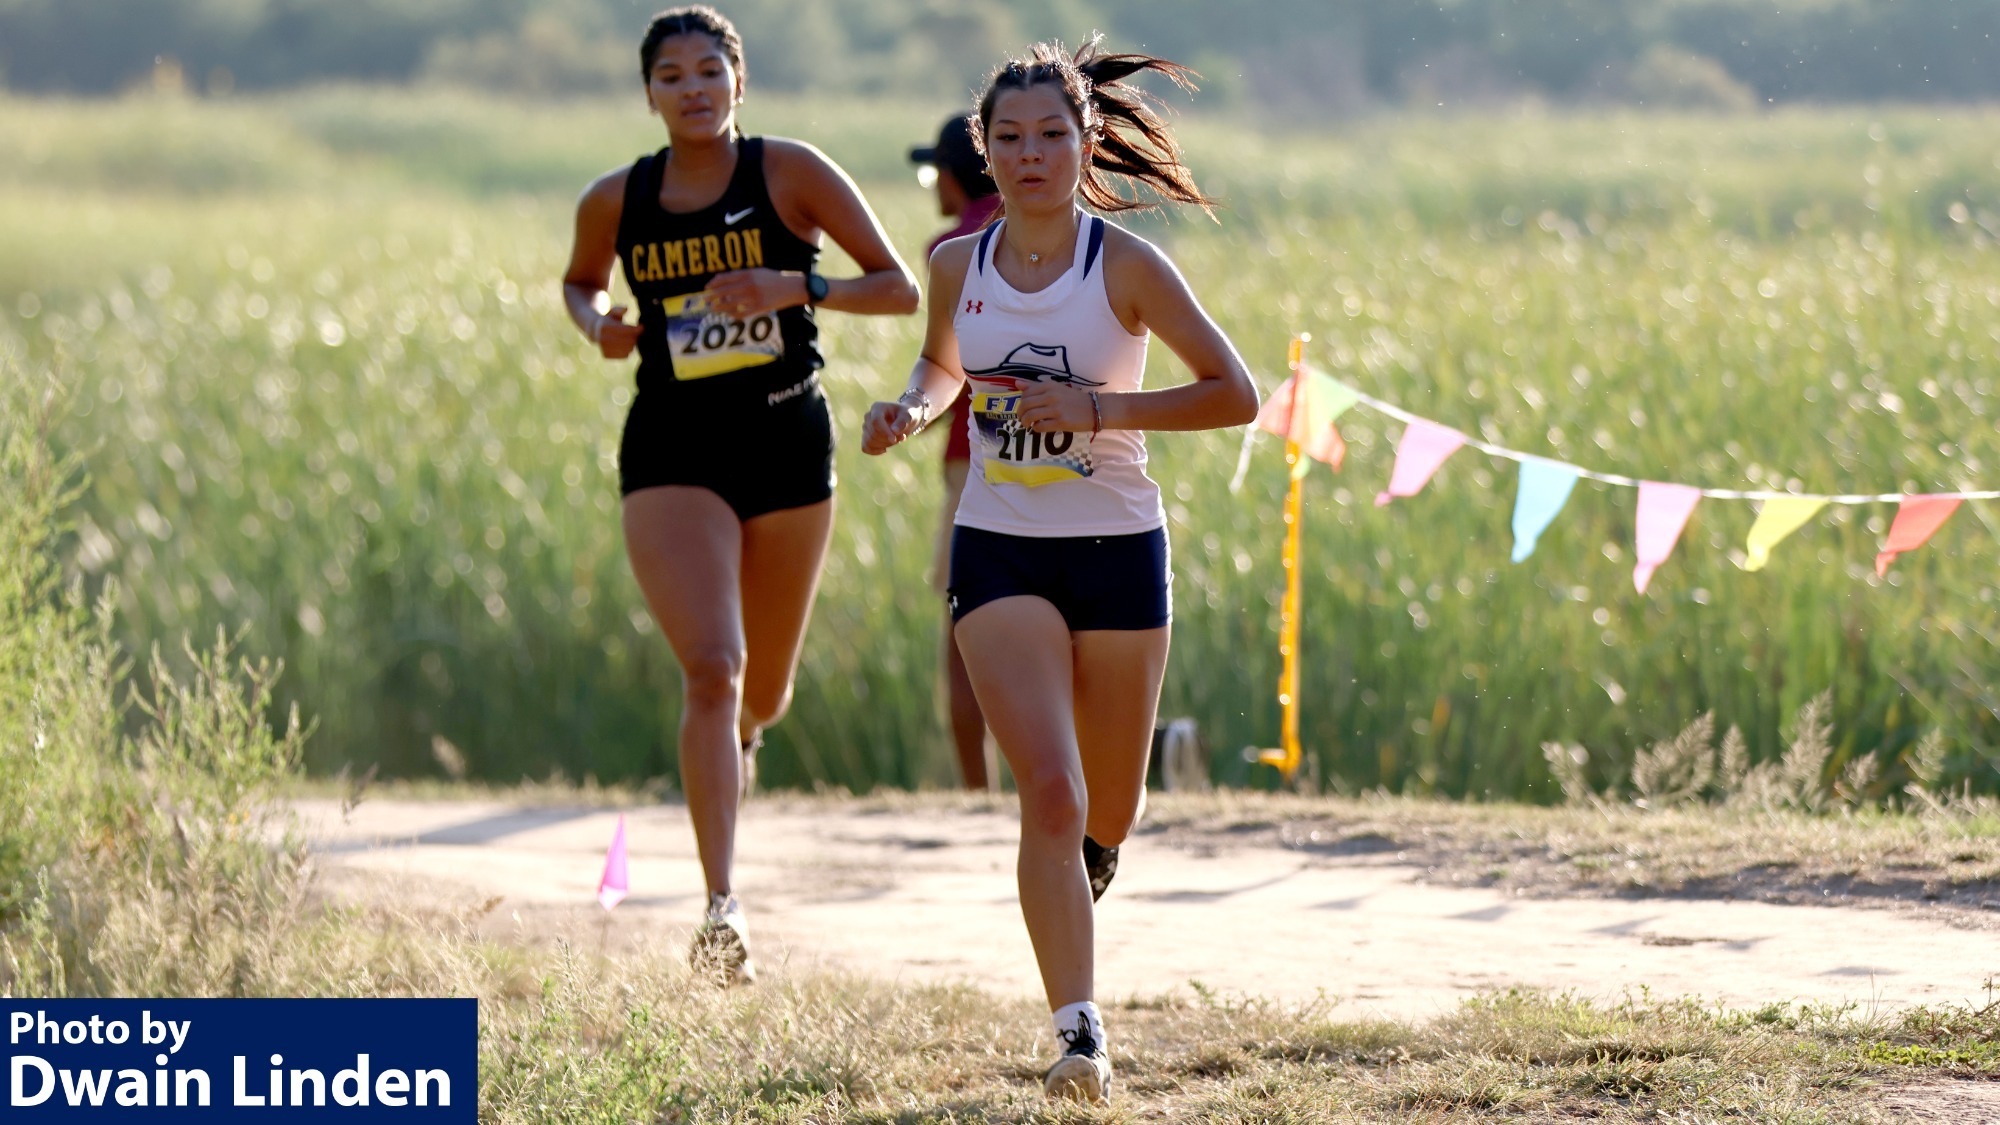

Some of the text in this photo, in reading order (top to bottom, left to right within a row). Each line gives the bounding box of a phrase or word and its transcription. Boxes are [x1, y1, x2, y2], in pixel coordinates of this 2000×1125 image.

[632, 228, 764, 282] CAMERON
[682, 315, 774, 354] 2020
[985, 394, 1022, 413] FT
[995, 427, 1074, 462] 2110
